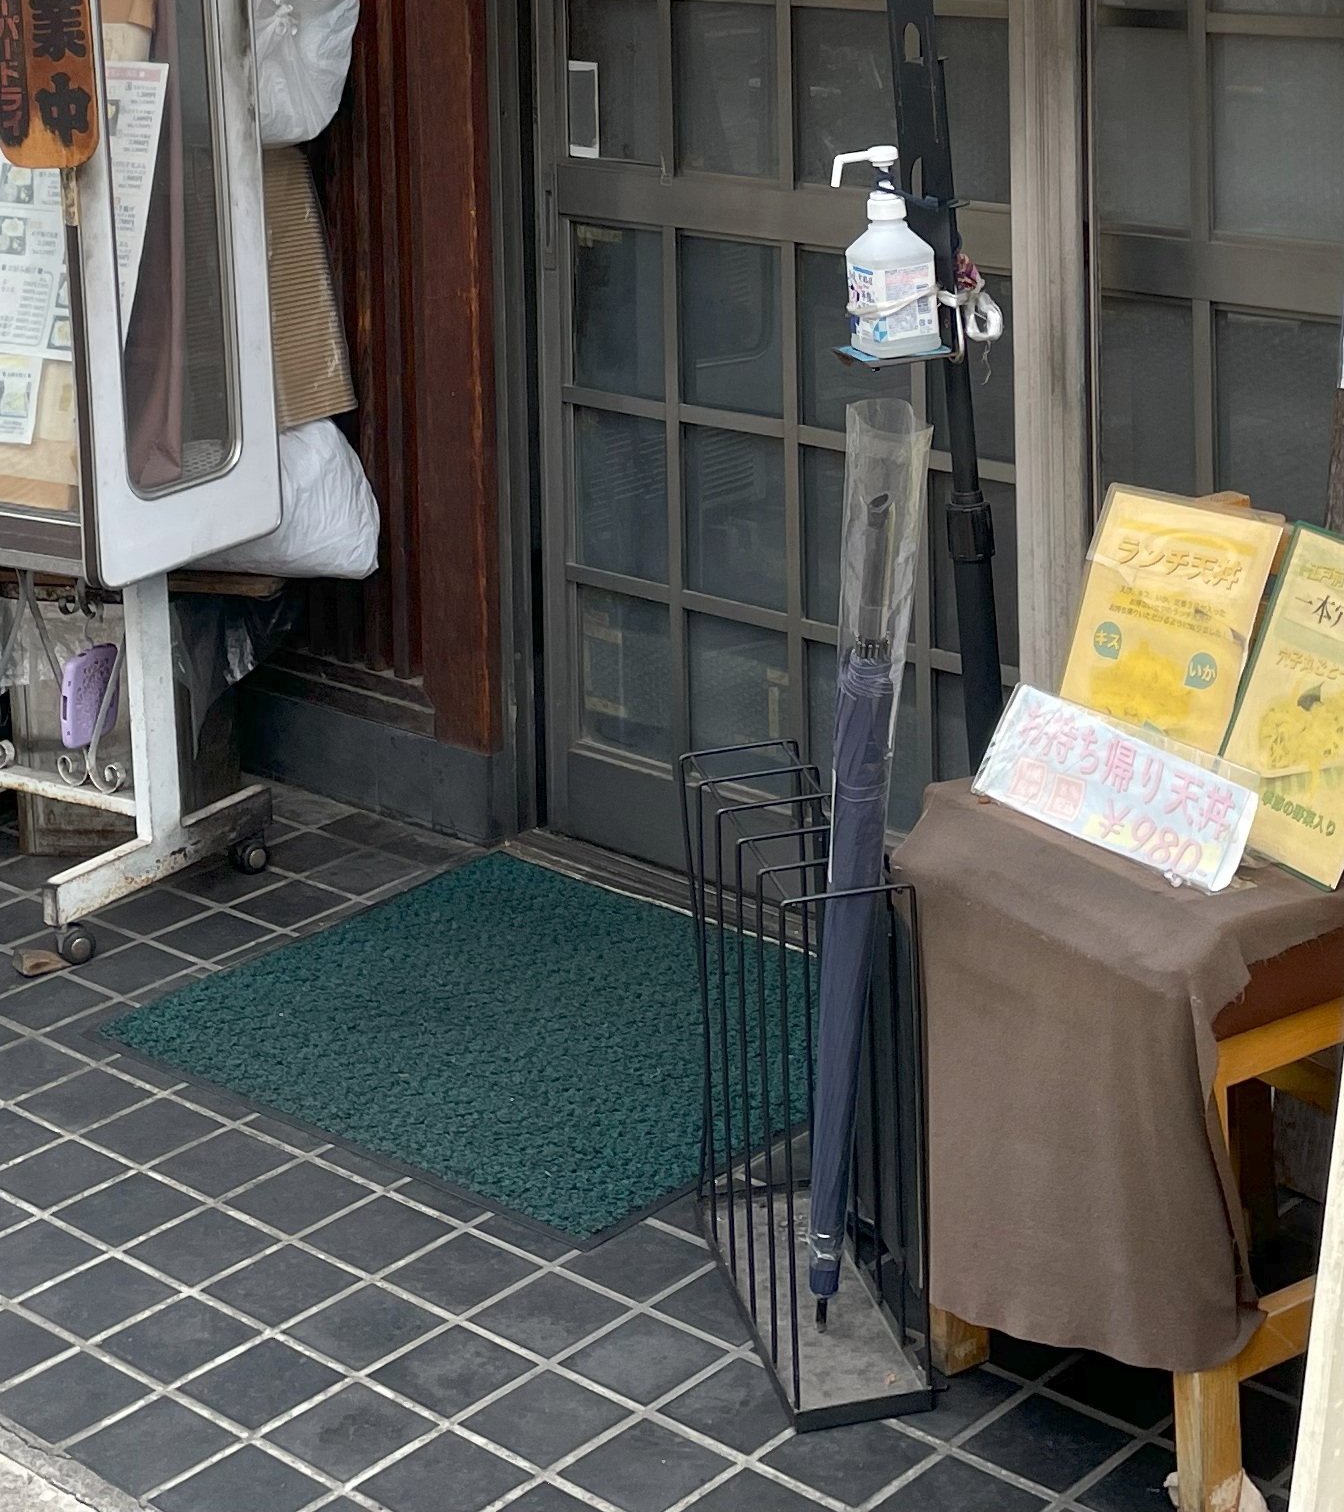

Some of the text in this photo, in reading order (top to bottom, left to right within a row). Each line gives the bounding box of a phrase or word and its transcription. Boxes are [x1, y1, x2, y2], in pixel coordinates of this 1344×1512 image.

[1118, 538, 1243, 591] ランチ天丼
[1094, 630, 1122, 650] キス
[1188, 661, 1216, 682] いか
[1019, 703, 1239, 842] お持ち帰り天丼
[1261, 789, 1337, 837] 季節の野菜入り
